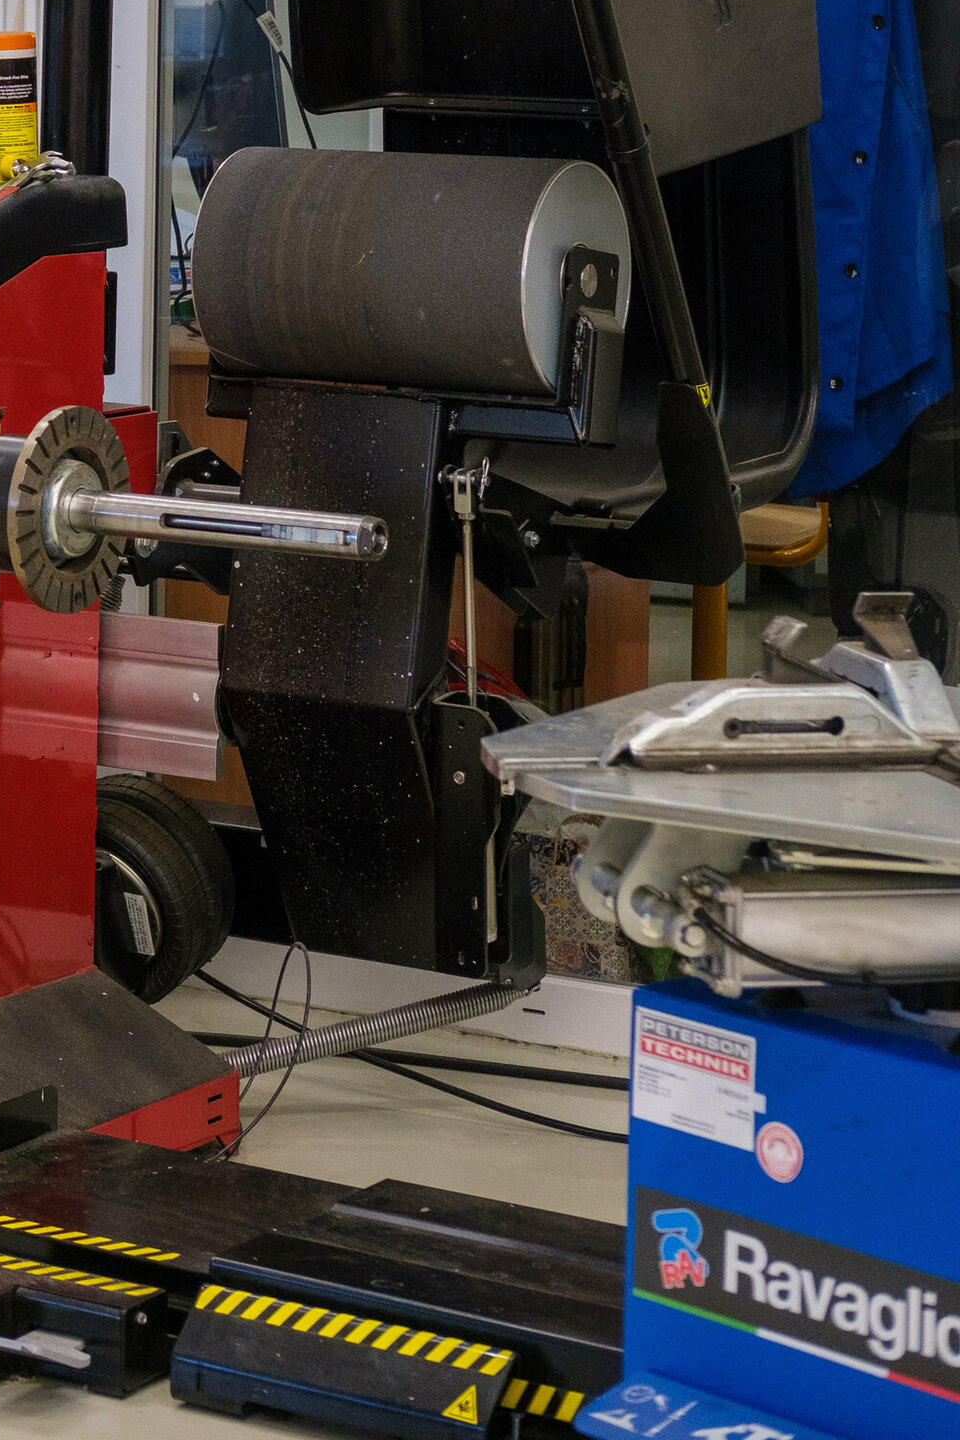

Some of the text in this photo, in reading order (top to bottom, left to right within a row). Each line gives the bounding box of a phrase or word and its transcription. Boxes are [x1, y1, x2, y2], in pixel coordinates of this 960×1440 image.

[642, 1017, 751, 1059] PETERSON
[642, 1037, 751, 1079] TECHNIK
[660, 1249, 707, 1290] RAV
